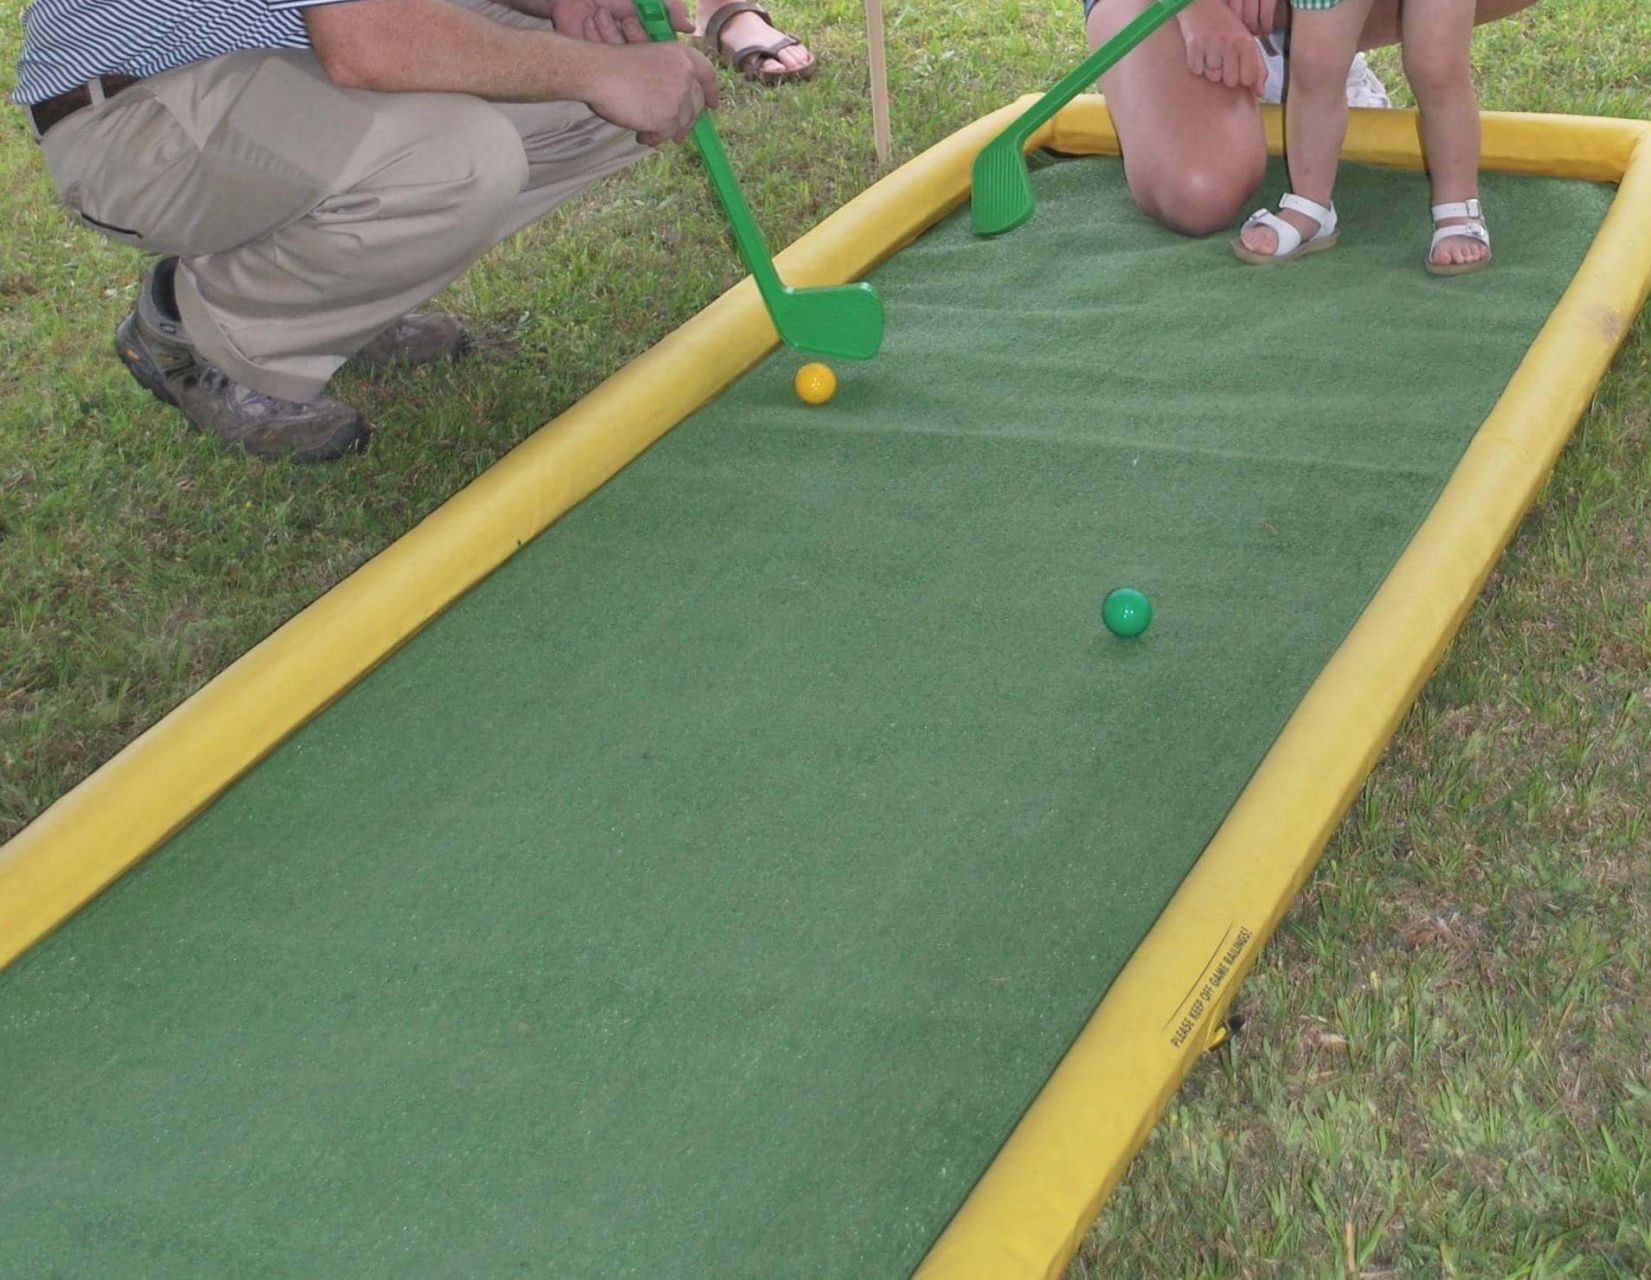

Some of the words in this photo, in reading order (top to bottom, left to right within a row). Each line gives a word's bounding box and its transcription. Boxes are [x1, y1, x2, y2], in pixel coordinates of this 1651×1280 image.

[1171, 1018, 1195, 1047] PLEASE
[1188, 998, 1205, 1020] KEEP
[1200, 984, 1214, 1001] OFF
[1210, 963, 1230, 987] GAME
